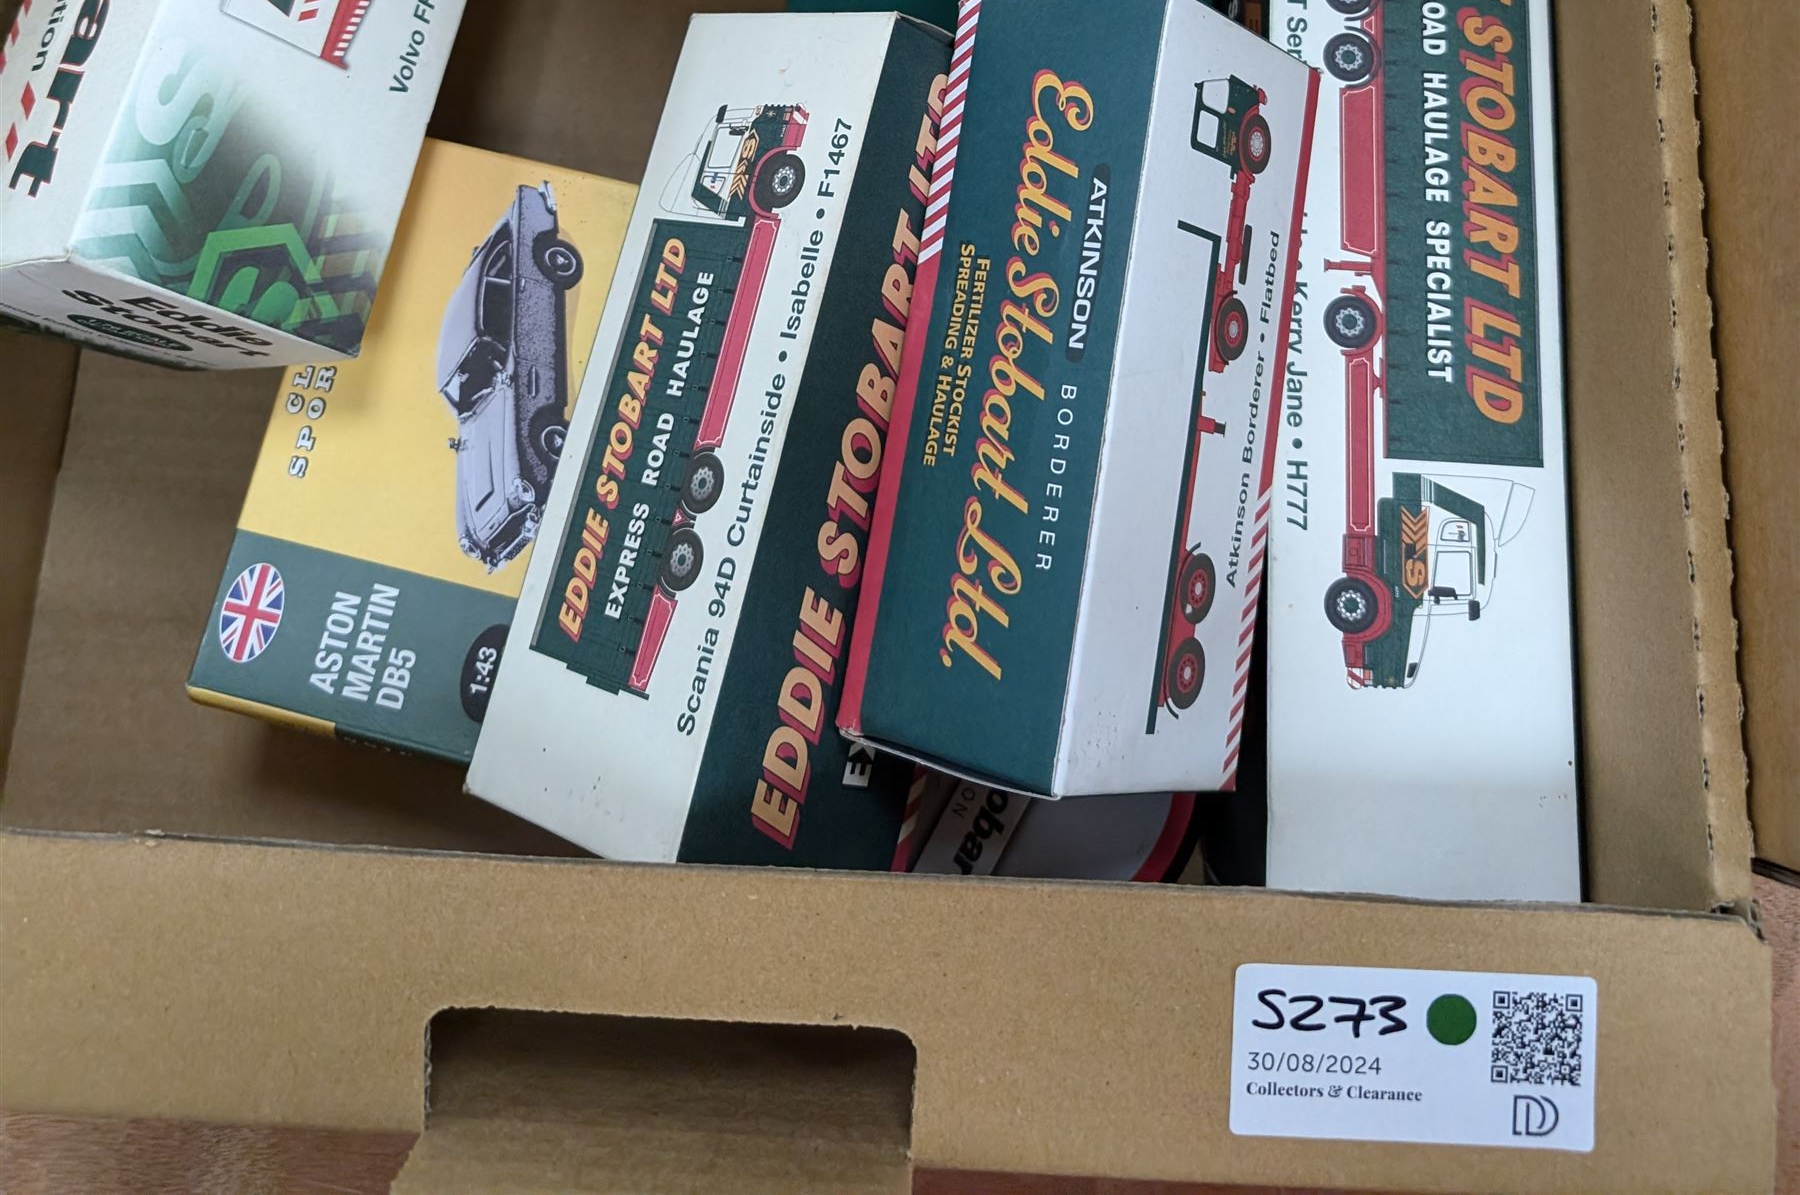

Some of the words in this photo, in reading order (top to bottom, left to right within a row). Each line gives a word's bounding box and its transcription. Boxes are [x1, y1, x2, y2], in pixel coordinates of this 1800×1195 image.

[388, 28, 426, 94] Volvo
[1012, 68, 1094, 258] Eddie
[1421, 70, 1450, 203] HAULAGE
[1455, 6, 1521, 299] STOBART
[944, 243, 976, 350] SPREADING
[960, 257, 991, 360] FERTILIZER
[1068, 177, 1109, 351] ATKINSON
[1423, 219, 1454, 385] SPECIALIST
[62, 288, 271, 358] Stobart
[119, 295, 274, 348] Eddie
[940, 355, 954, 369] &
[1463, 299, 1525, 426] LTD
[287, 364, 337, 478] SPOR
[557, 507, 611, 643] EDDIE
[595, 314, 665, 511] STOBART
[650, 236, 690, 315] LTD
[677, 624, 719, 738] Scania
[706, 555, 738, 620] 94D
[726, 373, 787, 548] Curtainside
[778, 228, 825, 341] Isabelle
[816, 117, 853, 198] F1467
[922, 374, 953, 467] HAULAGE
[943, 364, 972, 457] STOCKIST
[969, 256, 1060, 515] Stobart
[1226, 471, 1251, 590] Atkinson
[1241, 350, 1265, 466] Borderer
[1260, 230, 1280, 324] Flatbed
[1285, 360, 1308, 429] Jane
[604, 502, 650, 620] EXPRESS
[641, 412, 675, 488] ROAD
[666, 271, 715, 399] HAULAGE
[1035, 384, 1078, 572] BORDERER
[1285, 459, 1309, 532] H777
[750, 585, 847, 852] EDDIE
[816, 207, 925, 590] STOBART
[309, 590, 363, 695] ASTON
[341, 582, 400, 702] MARTIN
[938, 495, 1023, 682] Ltd.
[375, 648, 417, 710] DB5
[469, 646, 498, 695] 1:43
[1246, 1051, 1383, 1076] 30/08/2024
[1251, 987, 1409, 1039] S273
[1245, 1080, 1325, 1098] Collectors
[1326, 1084, 1343, 1098] &
[1346, 1084, 1423, 1102] Clearance
